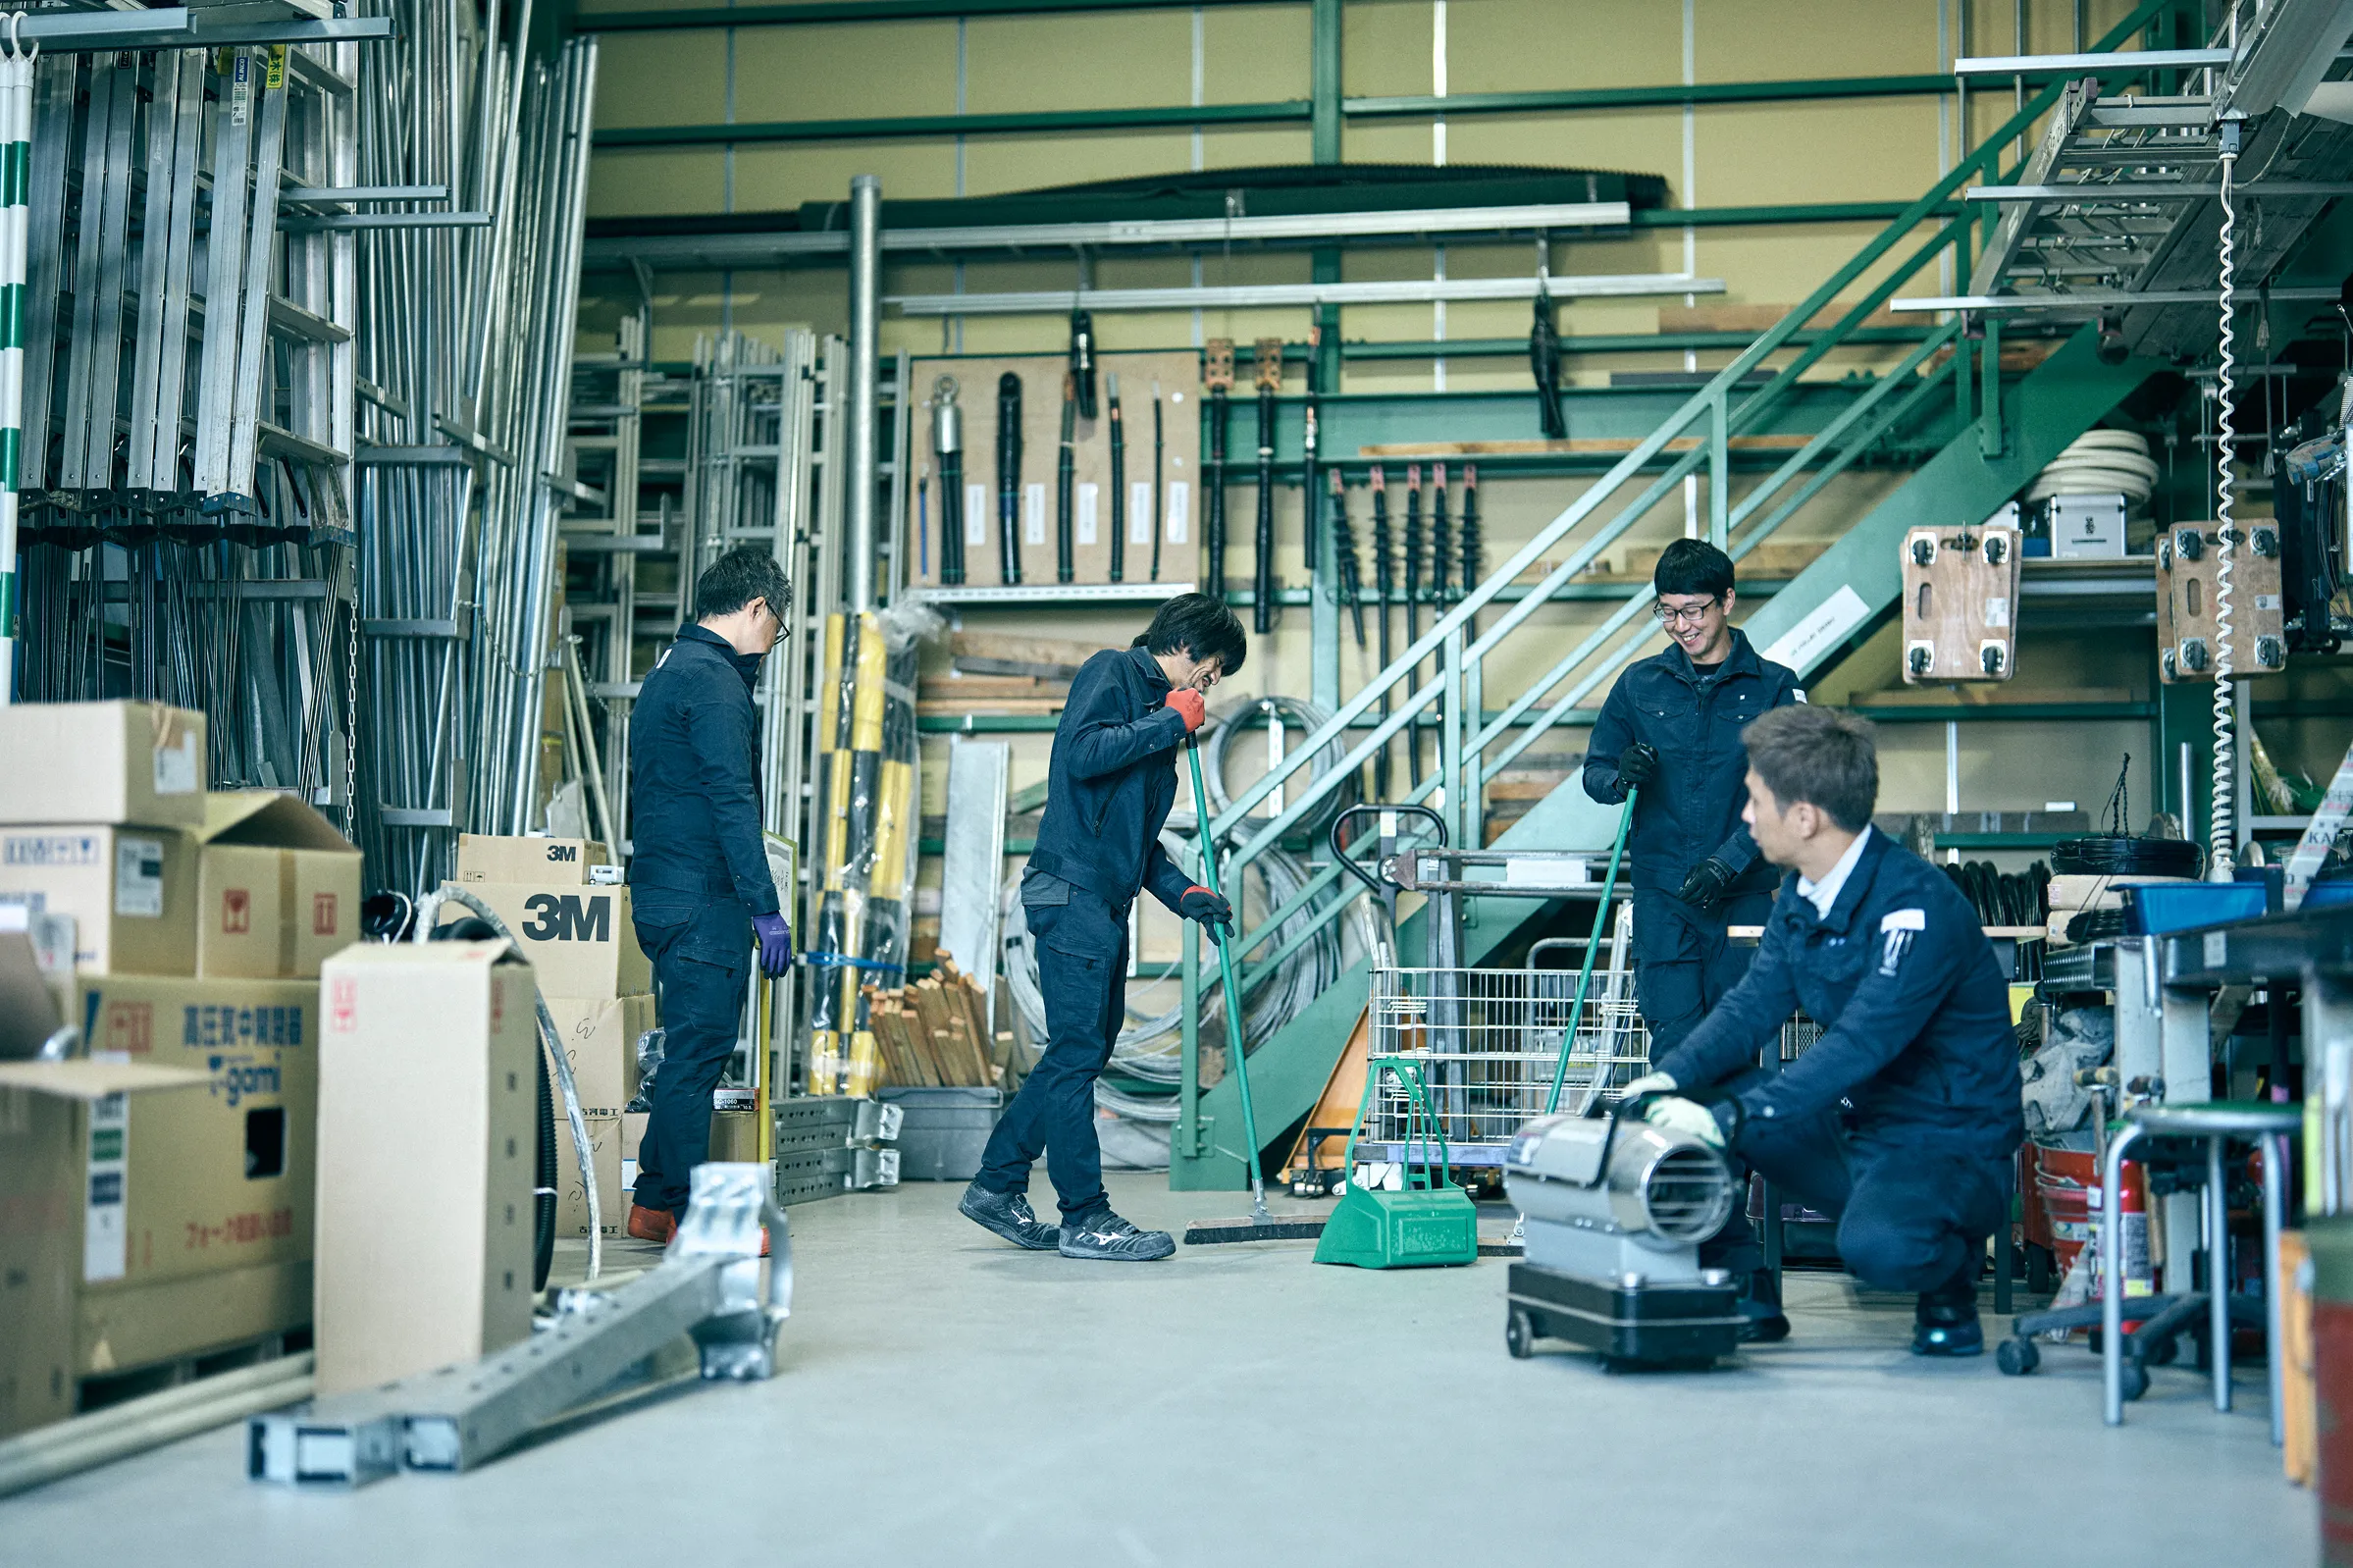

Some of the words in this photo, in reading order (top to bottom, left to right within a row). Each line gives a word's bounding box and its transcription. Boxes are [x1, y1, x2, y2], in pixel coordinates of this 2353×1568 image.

[547, 845, 577, 862] 3M
[522, 893, 611, 942] 3M
[579, 1225, 619, 1234] 古電工
